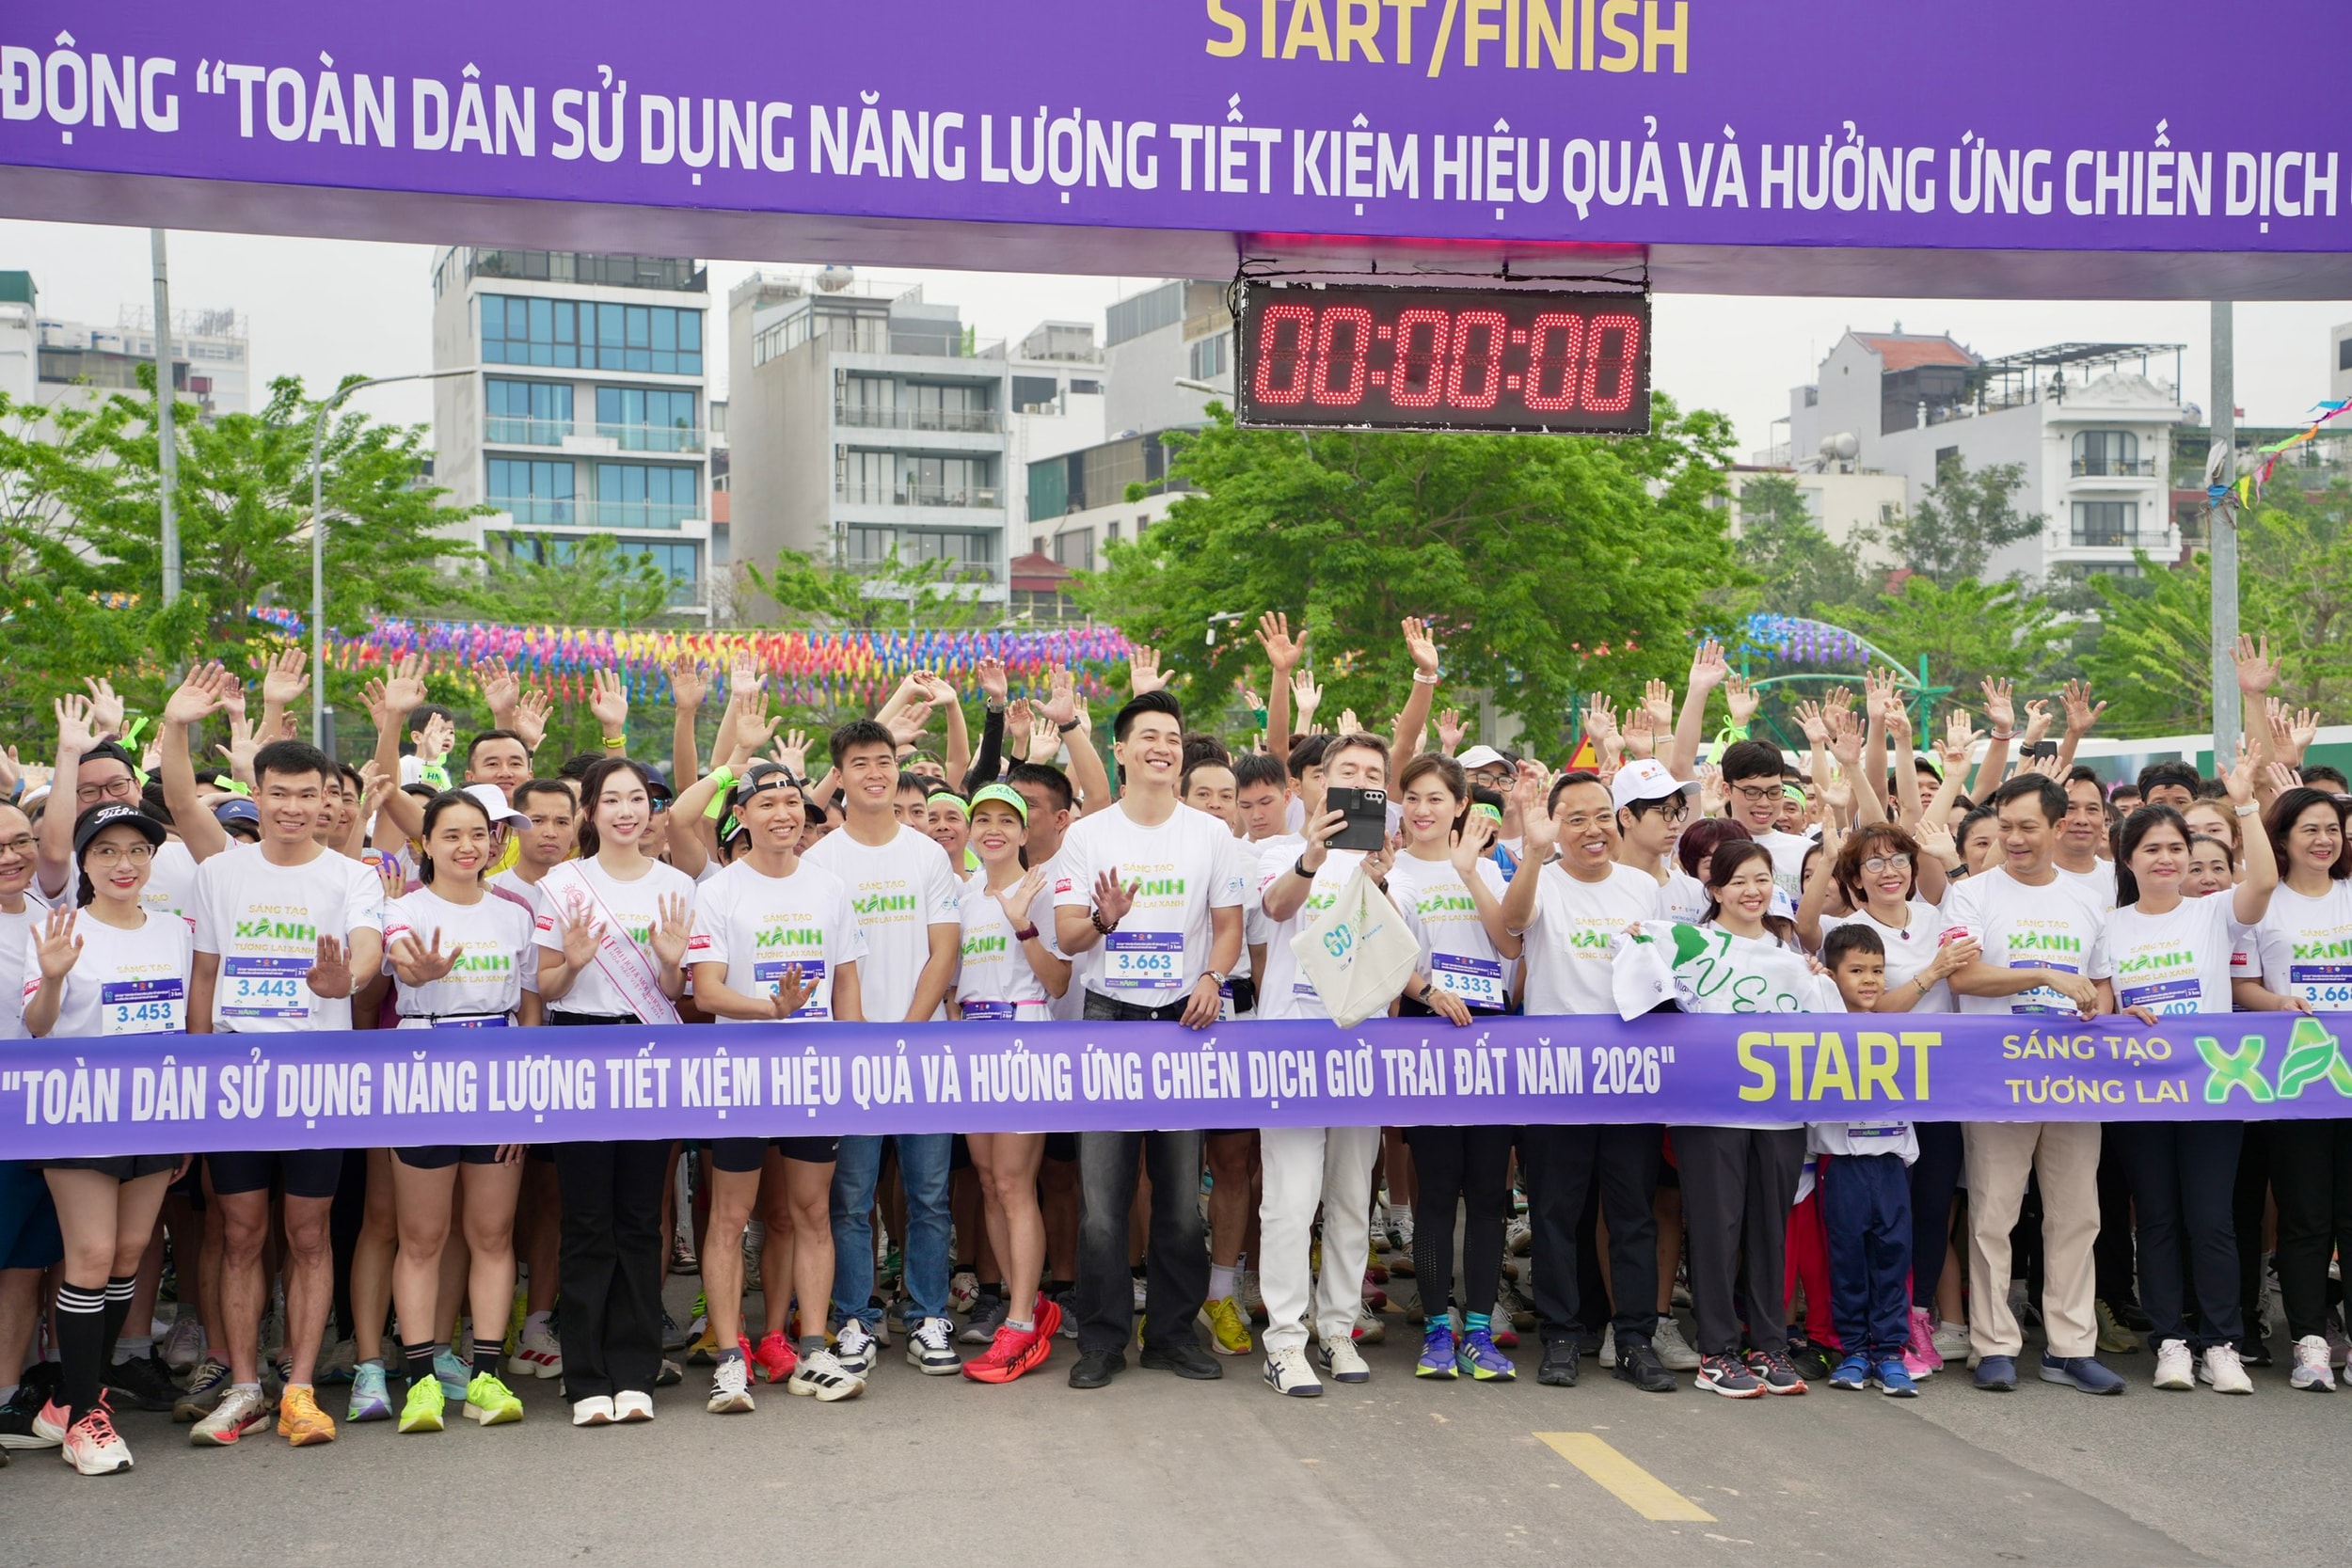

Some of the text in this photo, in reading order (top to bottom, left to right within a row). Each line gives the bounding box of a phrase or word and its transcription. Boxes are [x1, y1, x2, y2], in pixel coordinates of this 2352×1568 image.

[1205, 0, 1690, 78] START/FINISH
[0, 29, 179, 144] ĐỘNG
[413, 62, 535, 157] DÂN
[551, 64, 626, 163] SỬ
[641, 93, 794, 185] DỤNG
[810, 90, 965, 182] NĂNG
[981, 106, 1157, 203] LƯỢNG
[1170, 92, 1282, 195] TIẾT
[1294, 113, 1418, 215] KIỆM
[1434, 117, 1549, 220] HIỆU
[1564, 116, 1668, 221] QUẢ
[1678, 123, 1748, 208] VÀ
[1761, 120, 1935, 213] HƯỞNG
[1949, 129, 2052, 215] ỨNG
[2066, 118, 2212, 216] CHIẾN
[2226, 151, 2338, 233] DỊCH
[1255, 305, 1640, 412] 00:00:00
[1154, 864, 1174, 873] TẠO
[249, 903, 308, 917] SÁNG TẠO
[851, 894, 915, 914] XANH
[1306, 894, 1337, 911] XA
[763, 912, 812, 922] SÁNG TẠO
[858, 917, 879, 926] ƯƠNG
[2047, 920, 2069, 928] TẠO
[235, 917, 316, 941] XANH
[755, 926, 822, 948] XANH
[1569, 929, 1611, 946] XA
[2301, 928, 2329, 937] SÁNG
[234, 942, 268, 951] TƯƠNG
[287, 945, 315, 954] XANH
[477, 941, 498, 949] TẠO
[2008, 930, 2080, 952] XANH
[453, 953, 510, 972] ANH
[1119, 954, 1171, 969] 3.663
[1575, 952, 1597, 960] ƯƠNG
[2119, 951, 2193, 974] XANH
[151, 963, 172, 973] TẠO
[2119, 974, 2151, 984] TƯƠNG
[2169, 967, 2196, 977] XANH
[237, 979, 296, 996] 3.443
[1444, 974, 1491, 993] 3.333
[2306, 986, 2352, 1001] 3.66
[117, 1003, 171, 1022] 3.453
[2001, 1029, 2172, 1068] SÁNG TẠO
[1737, 1030, 1943, 1102] START
[2, 1032, 1675, 1130] "TOÀN DÂN SỬ DỤNG NĂNG LƯỢNG TIẾT KIỆM HIỆU QUẢ VÀ HƯỞNG ỨNG CHIẾN DỊCH GIỜ TRÁI ĐẤT NĂM 2026"
[2004, 1076, 2189, 1105] TƯƠNG LAI
